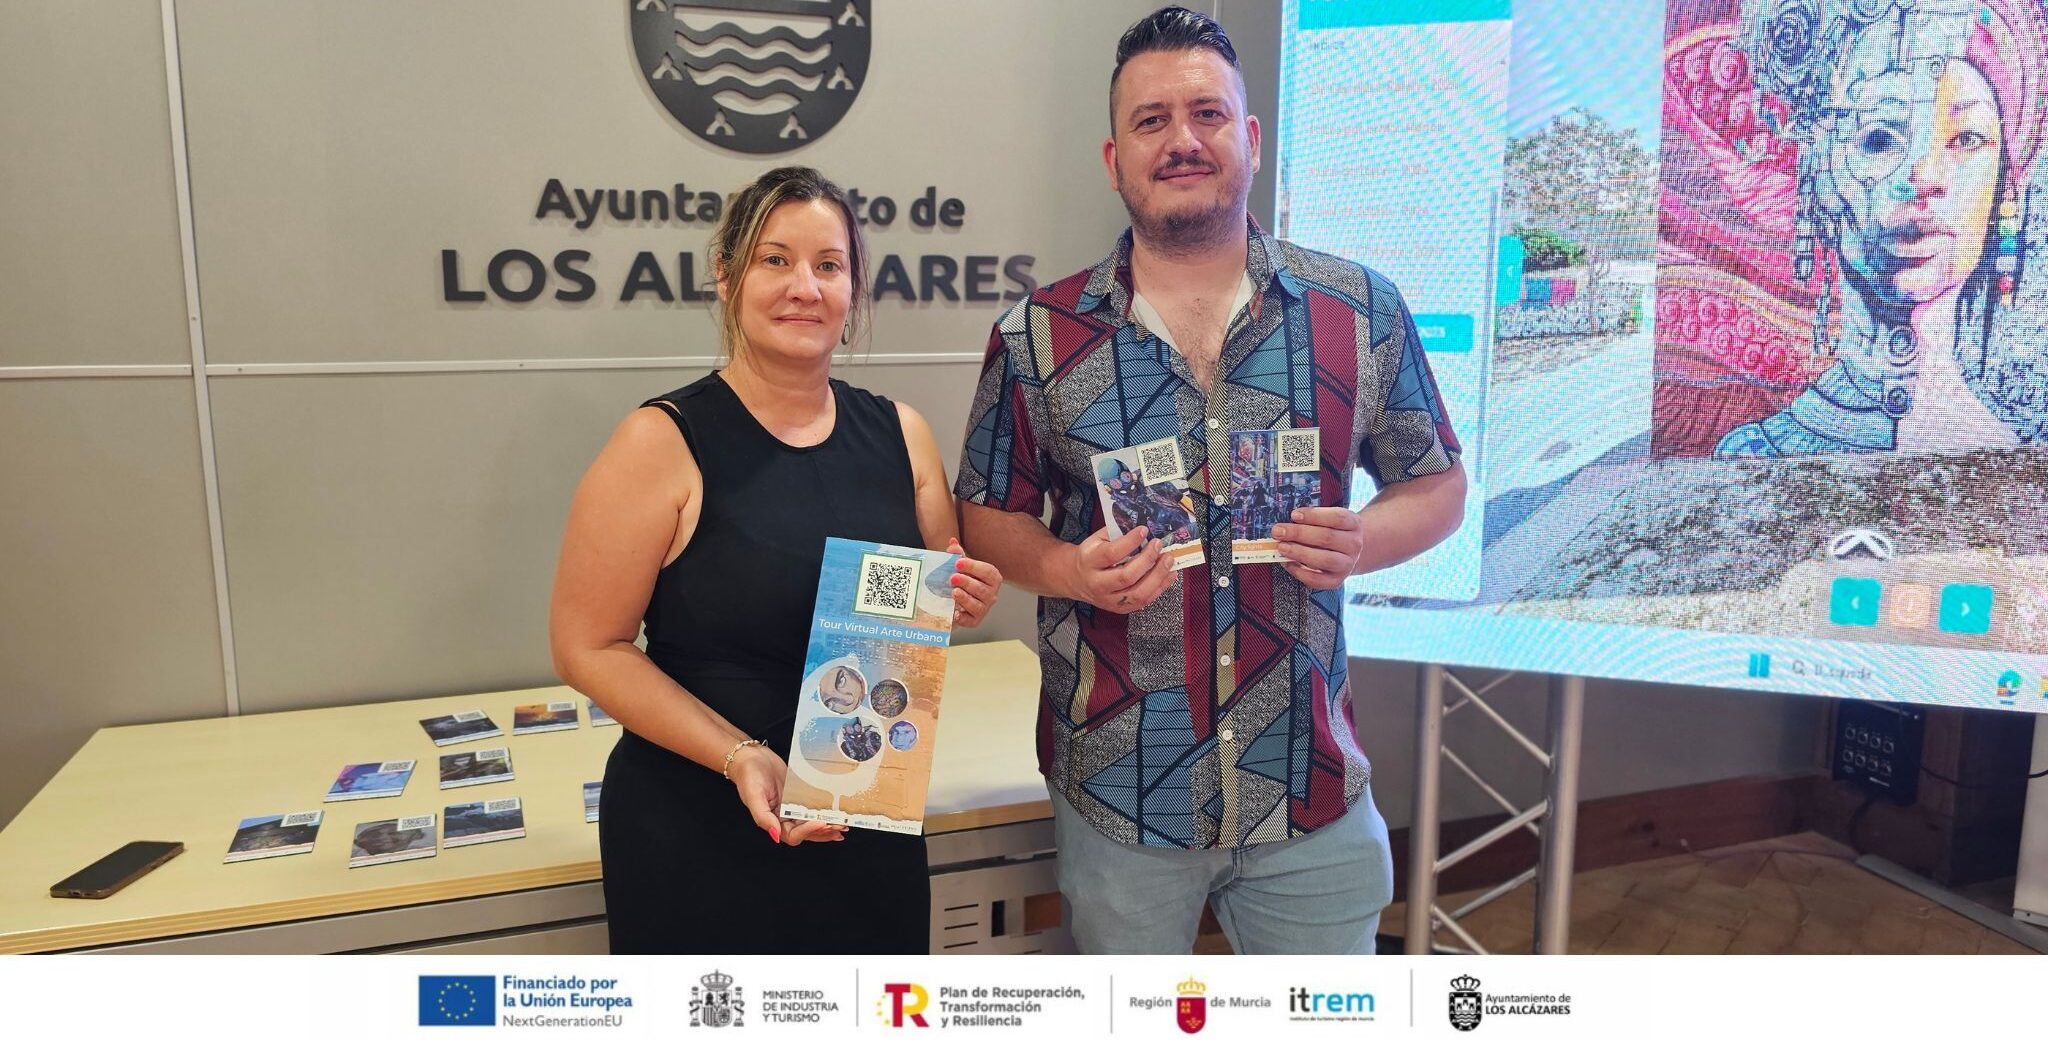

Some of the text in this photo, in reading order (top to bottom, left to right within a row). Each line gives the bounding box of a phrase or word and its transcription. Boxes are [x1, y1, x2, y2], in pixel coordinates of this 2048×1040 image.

[535, 178, 966, 229] Ayuntato de
[441, 249, 1038, 303] LOS ALARES
[819, 618, 944, 643] Tour Virtual Arte Urbano
